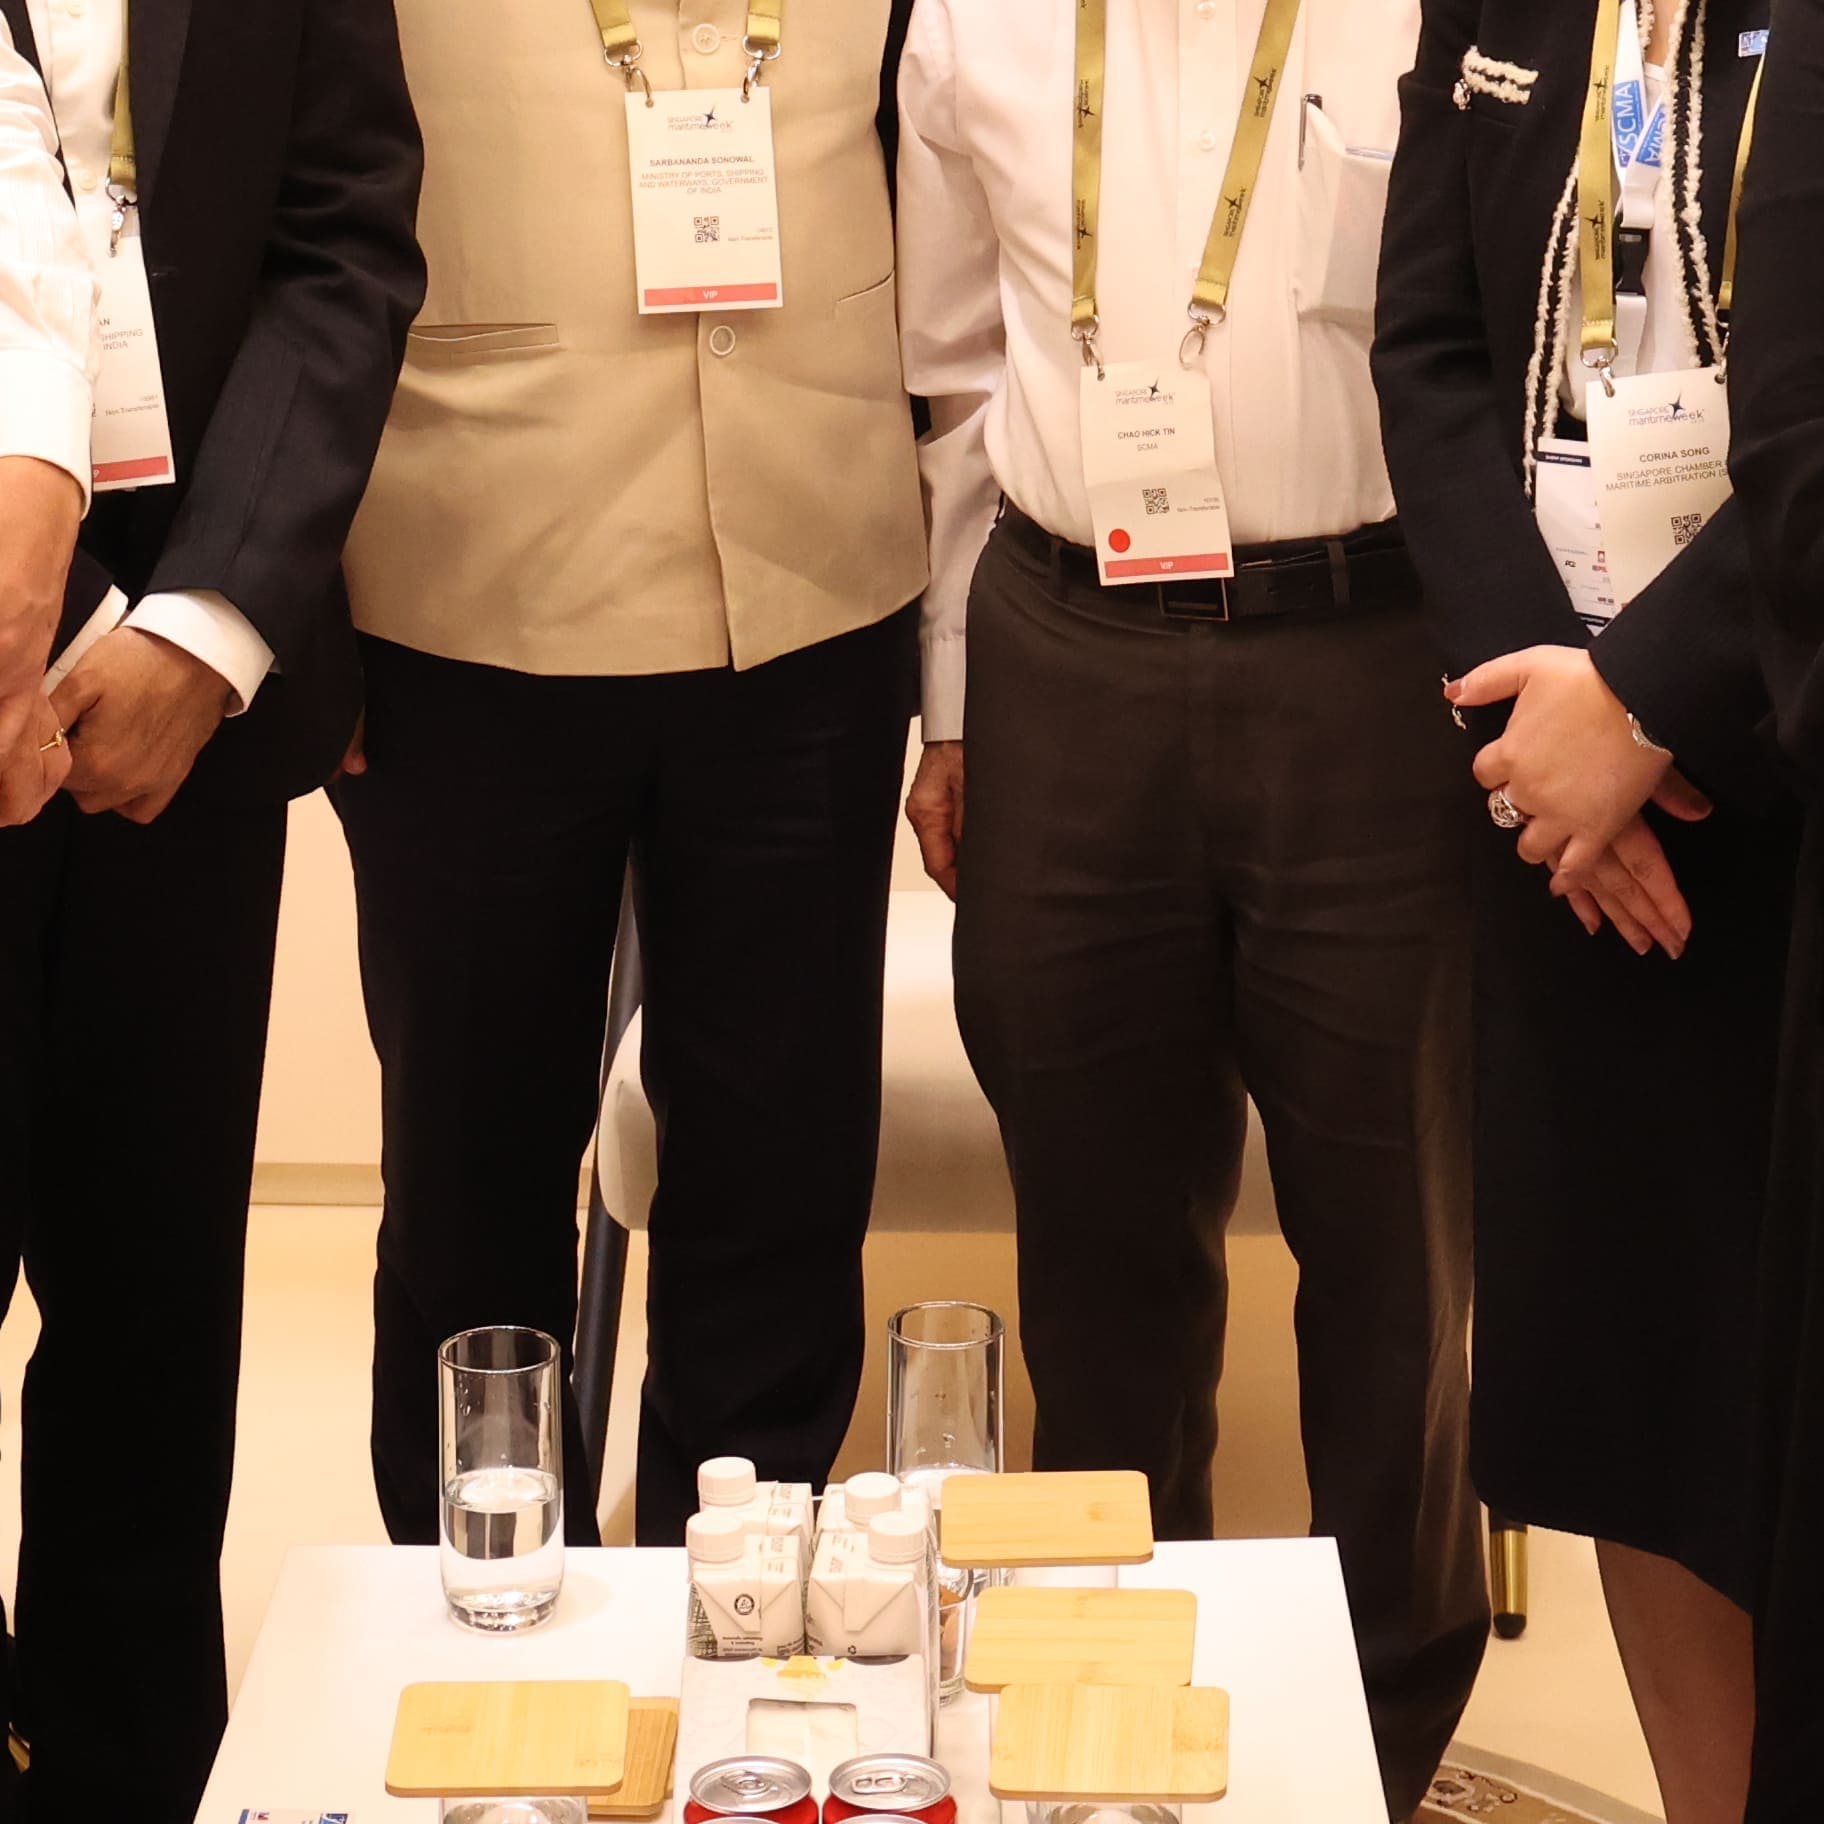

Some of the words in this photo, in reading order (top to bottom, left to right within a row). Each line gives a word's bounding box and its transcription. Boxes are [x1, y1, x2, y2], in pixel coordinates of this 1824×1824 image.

[711, 156, 755, 164] SONOWAL
[703, 290, 719, 299] VIP
[102, 341, 129, 350] INDIA
[1639, 450, 1678, 463] CORINA
[1680, 446, 1710, 458] SONG
[1617, 466, 1673, 481] SINGAPORE
[1674, 459, 1724, 475] CHAMBER
[1606, 478, 1652, 491] MARITIME
[1653, 470, 1717, 486] ARBITRATION
[1159, 560, 1174, 569] VIP
